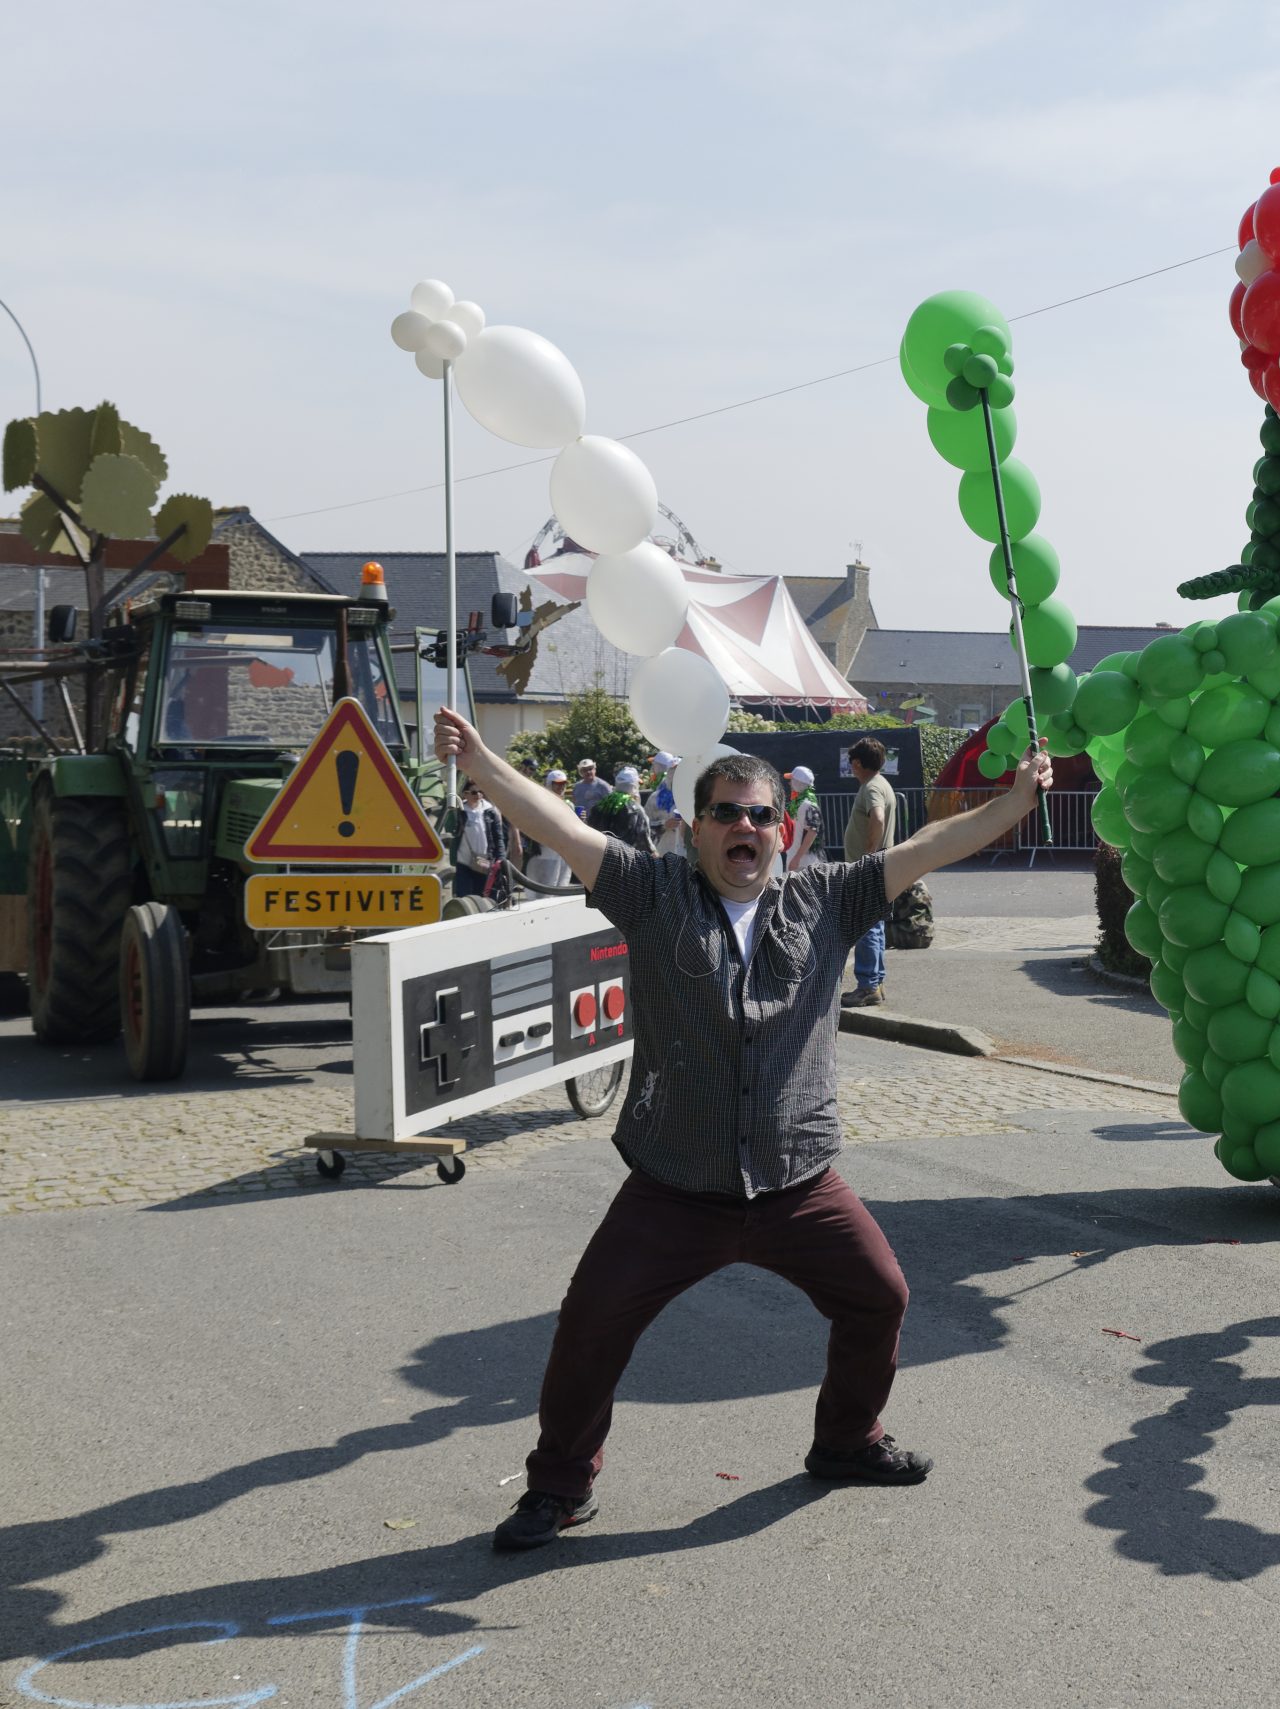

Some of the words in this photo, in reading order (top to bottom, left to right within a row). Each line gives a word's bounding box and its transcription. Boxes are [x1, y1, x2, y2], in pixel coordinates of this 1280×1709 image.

[264, 885, 424, 912] FESTIVITÉ
[590, 943, 628, 960] Nintendo
[617, 1023, 624, 1036] B
[589, 1033, 596, 1046] A
